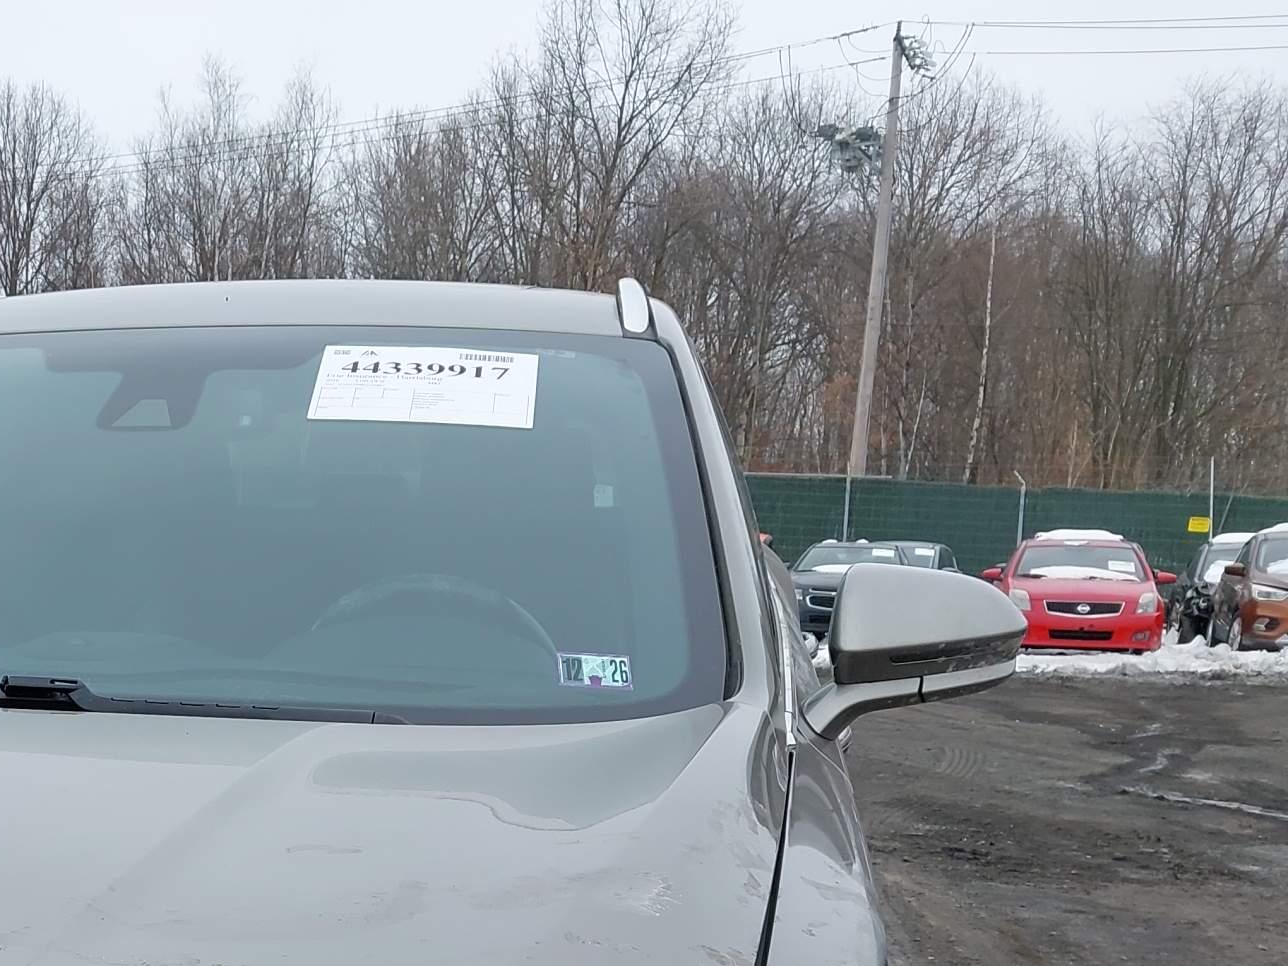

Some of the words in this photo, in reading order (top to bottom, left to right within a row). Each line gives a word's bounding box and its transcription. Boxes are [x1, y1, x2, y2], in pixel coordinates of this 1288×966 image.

[341, 360, 510, 379] 44339917
[562, 658, 584, 681] 12
[609, 659, 629, 683] 26
